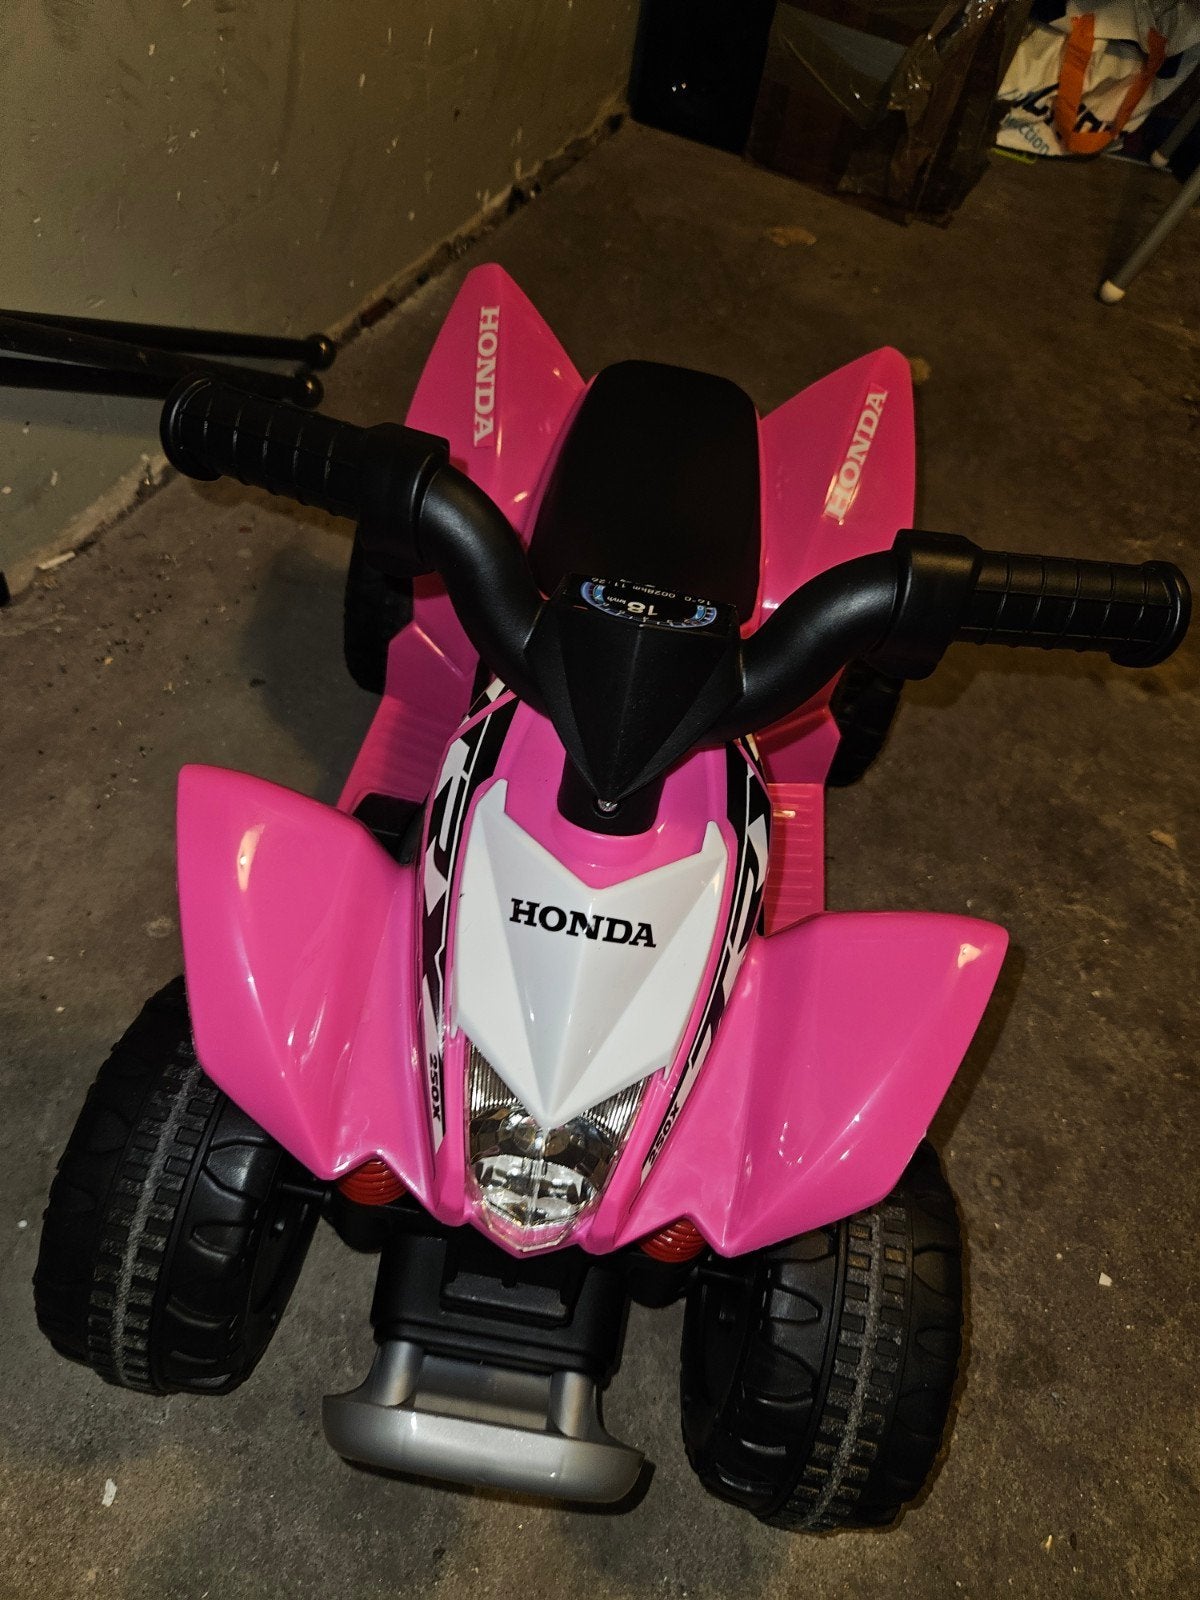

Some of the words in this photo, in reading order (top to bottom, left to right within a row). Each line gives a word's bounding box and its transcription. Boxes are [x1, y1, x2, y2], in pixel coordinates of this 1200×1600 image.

[473, 305, 500, 447] HONDA
[822, 391, 889, 522] HONDA
[627, 601, 658, 616] 18
[509, 897, 657, 948] HONDA
[429, 1053, 441, 1122] 250X
[648, 1101, 680, 1166] 250X
